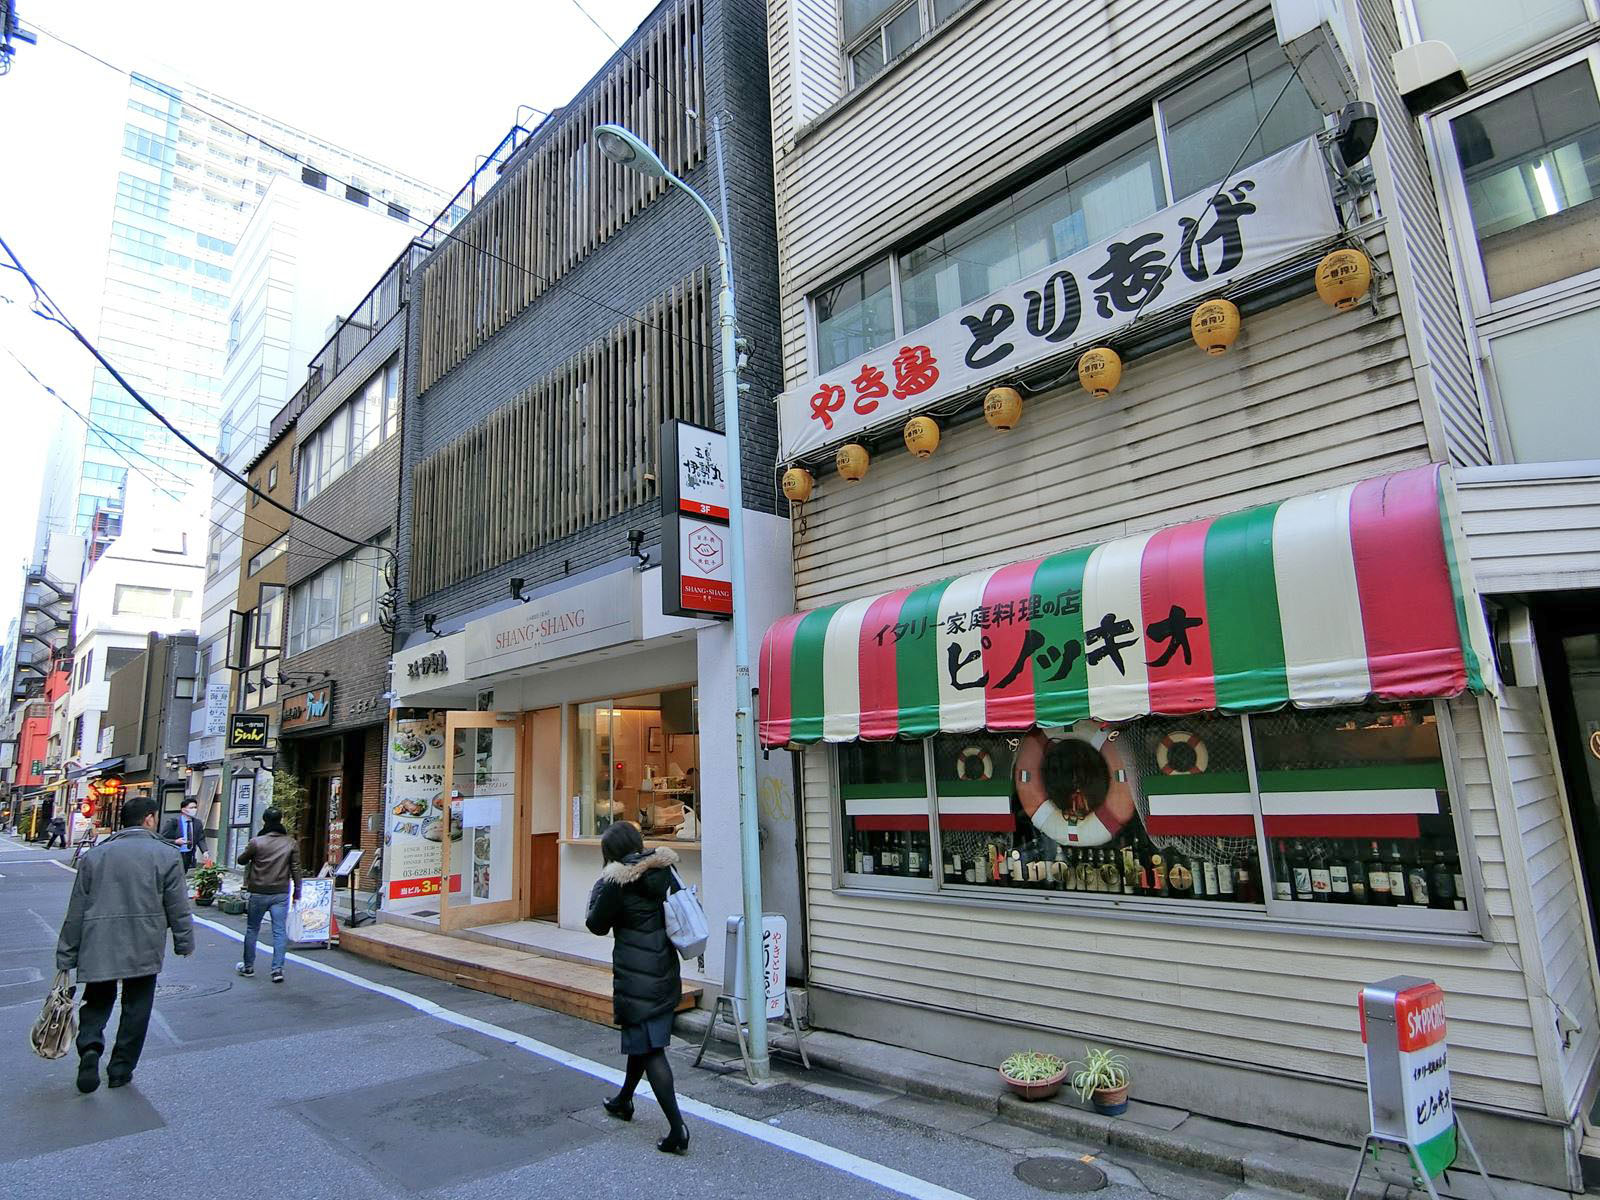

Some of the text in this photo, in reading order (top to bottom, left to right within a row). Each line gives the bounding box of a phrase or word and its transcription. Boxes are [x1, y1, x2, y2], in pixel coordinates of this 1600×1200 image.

[810, 345, 940, 429] やき鳥
[700, 504, 711, 513] 3F
[495, 609, 585, 650] SHANG SHANG
[872, 592, 1081, 647] イタリー家庭料理の店
[772, 931, 782, 986] やきとり
[770, 999, 779, 1008] 2F
